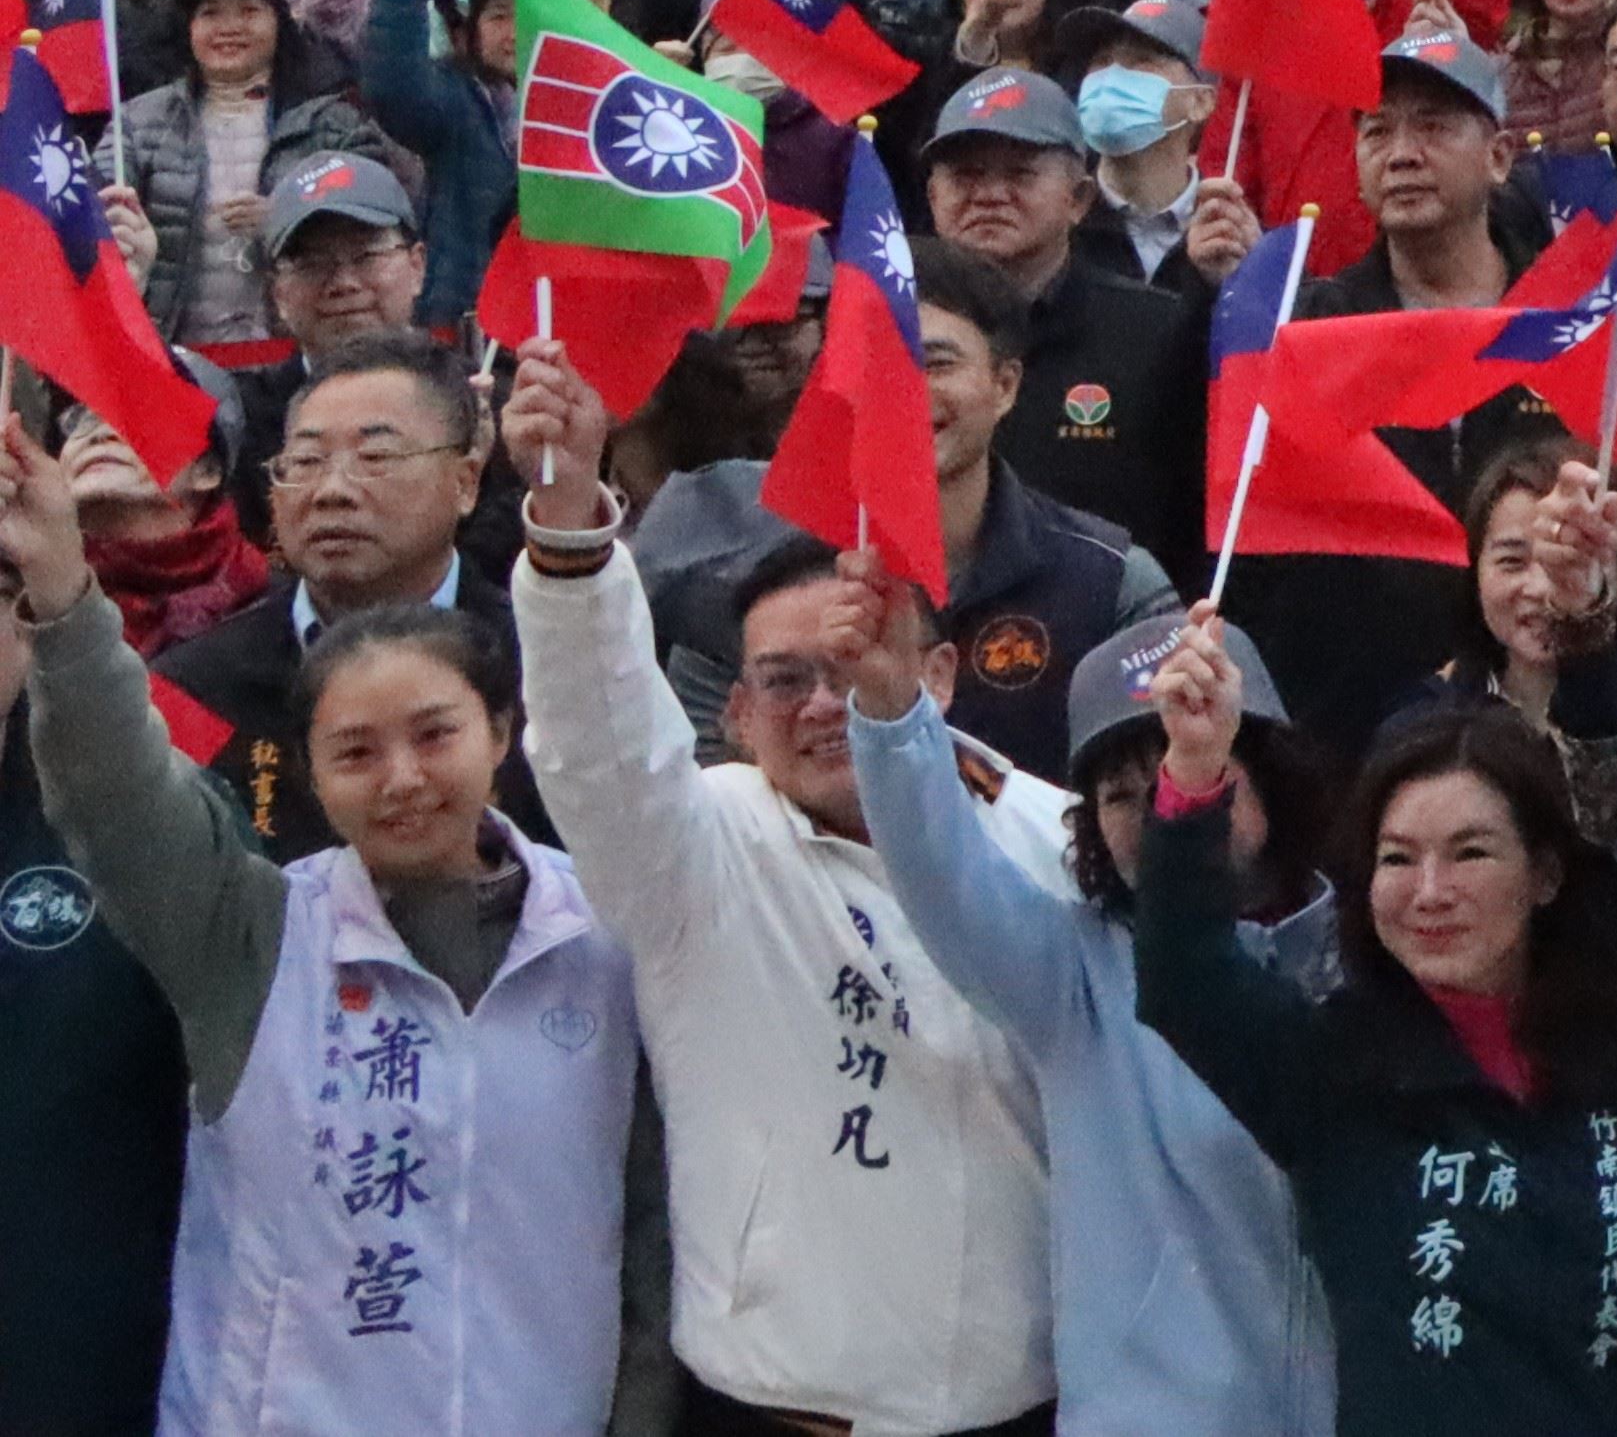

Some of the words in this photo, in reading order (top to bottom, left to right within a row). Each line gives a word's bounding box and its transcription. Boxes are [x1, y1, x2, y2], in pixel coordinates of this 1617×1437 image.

[250, 739, 278, 836] 秘書長
[831, 964, 890, 1169] 徐功凡
[343, 1016, 432, 1337] 蕭詠萱
[1409, 1144, 1477, 1359] 何秀綿
